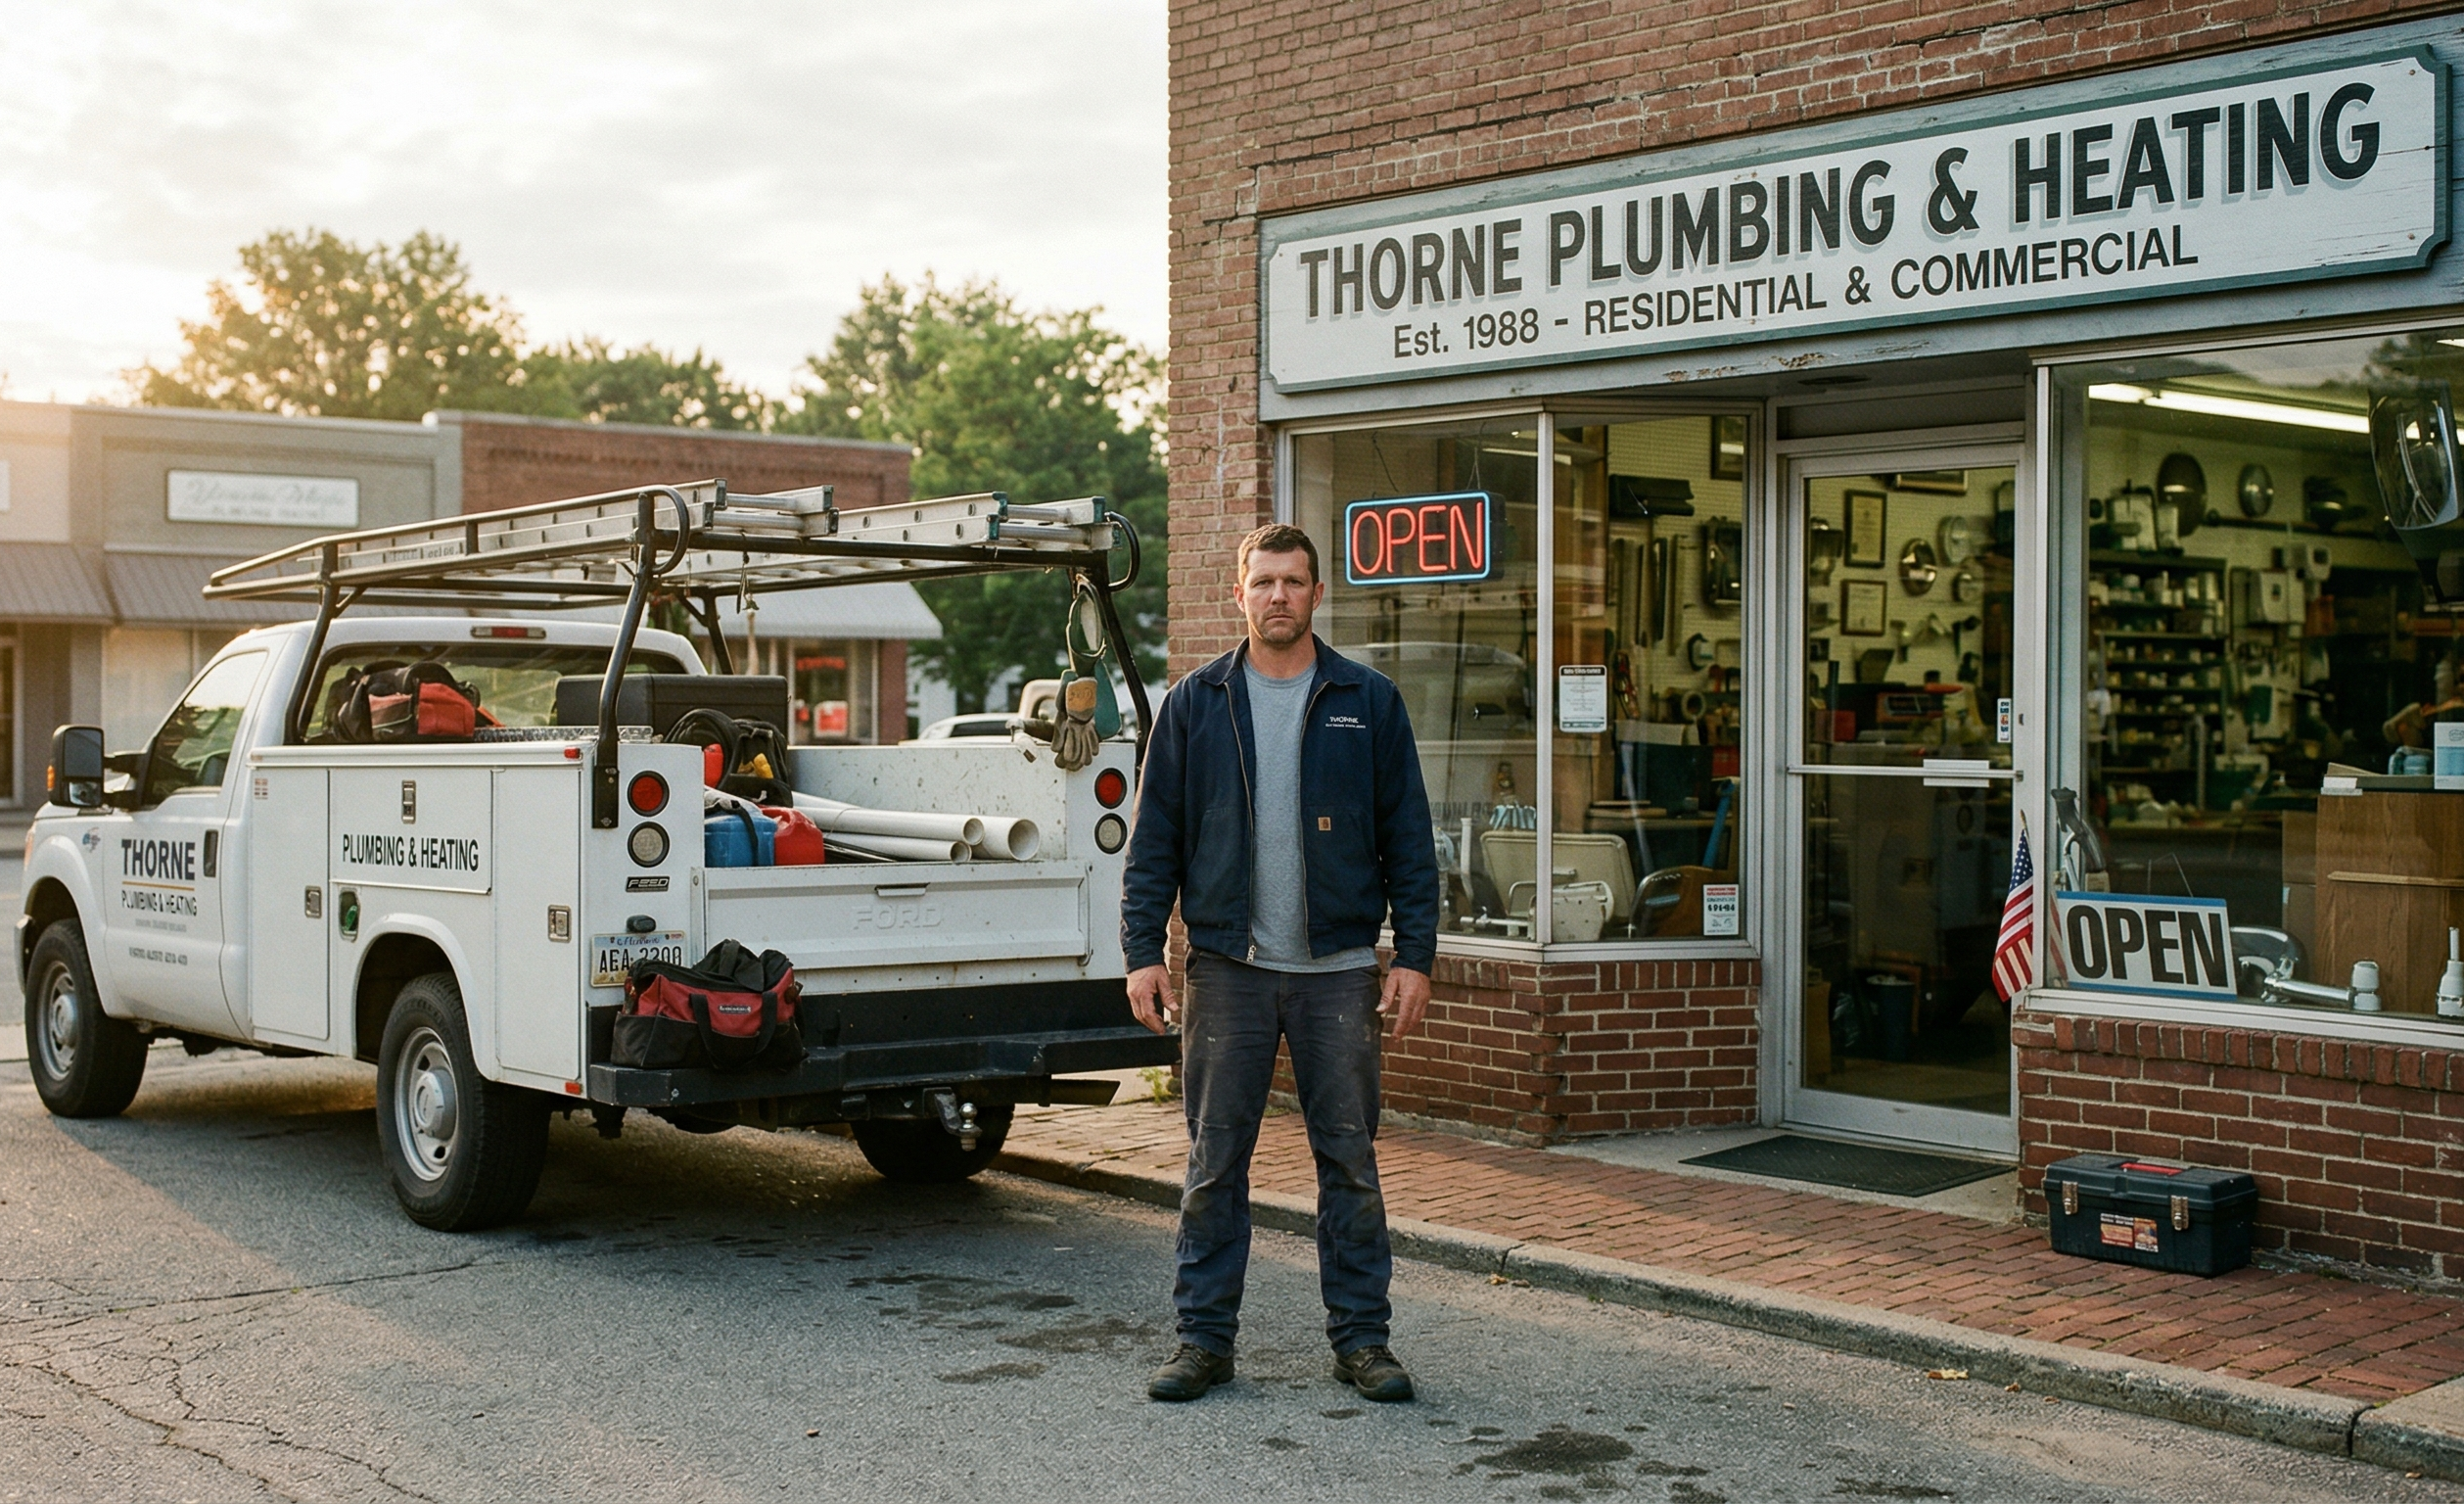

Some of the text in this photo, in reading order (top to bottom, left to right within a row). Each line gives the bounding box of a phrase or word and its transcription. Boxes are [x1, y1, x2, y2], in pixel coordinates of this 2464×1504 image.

[1298, 82, 2382, 318] THORNE PLUMBING & HEATING
[1394, 322, 1449, 358] Est.
[1463, 307, 1540, 350] 1988
[1584, 272, 1828, 336] RESIDENTIAL
[1844, 265, 1872, 306] &
[1890, 224, 2199, 300] COMMERCIAL
[1352, 501, 1483, 575] OPEN
[121, 838, 196, 880] THORNE
[343, 833, 479, 871] PLUMBING & HEATING
[851, 903, 943, 930] FORD
[2067, 905, 2229, 988] OPEN
